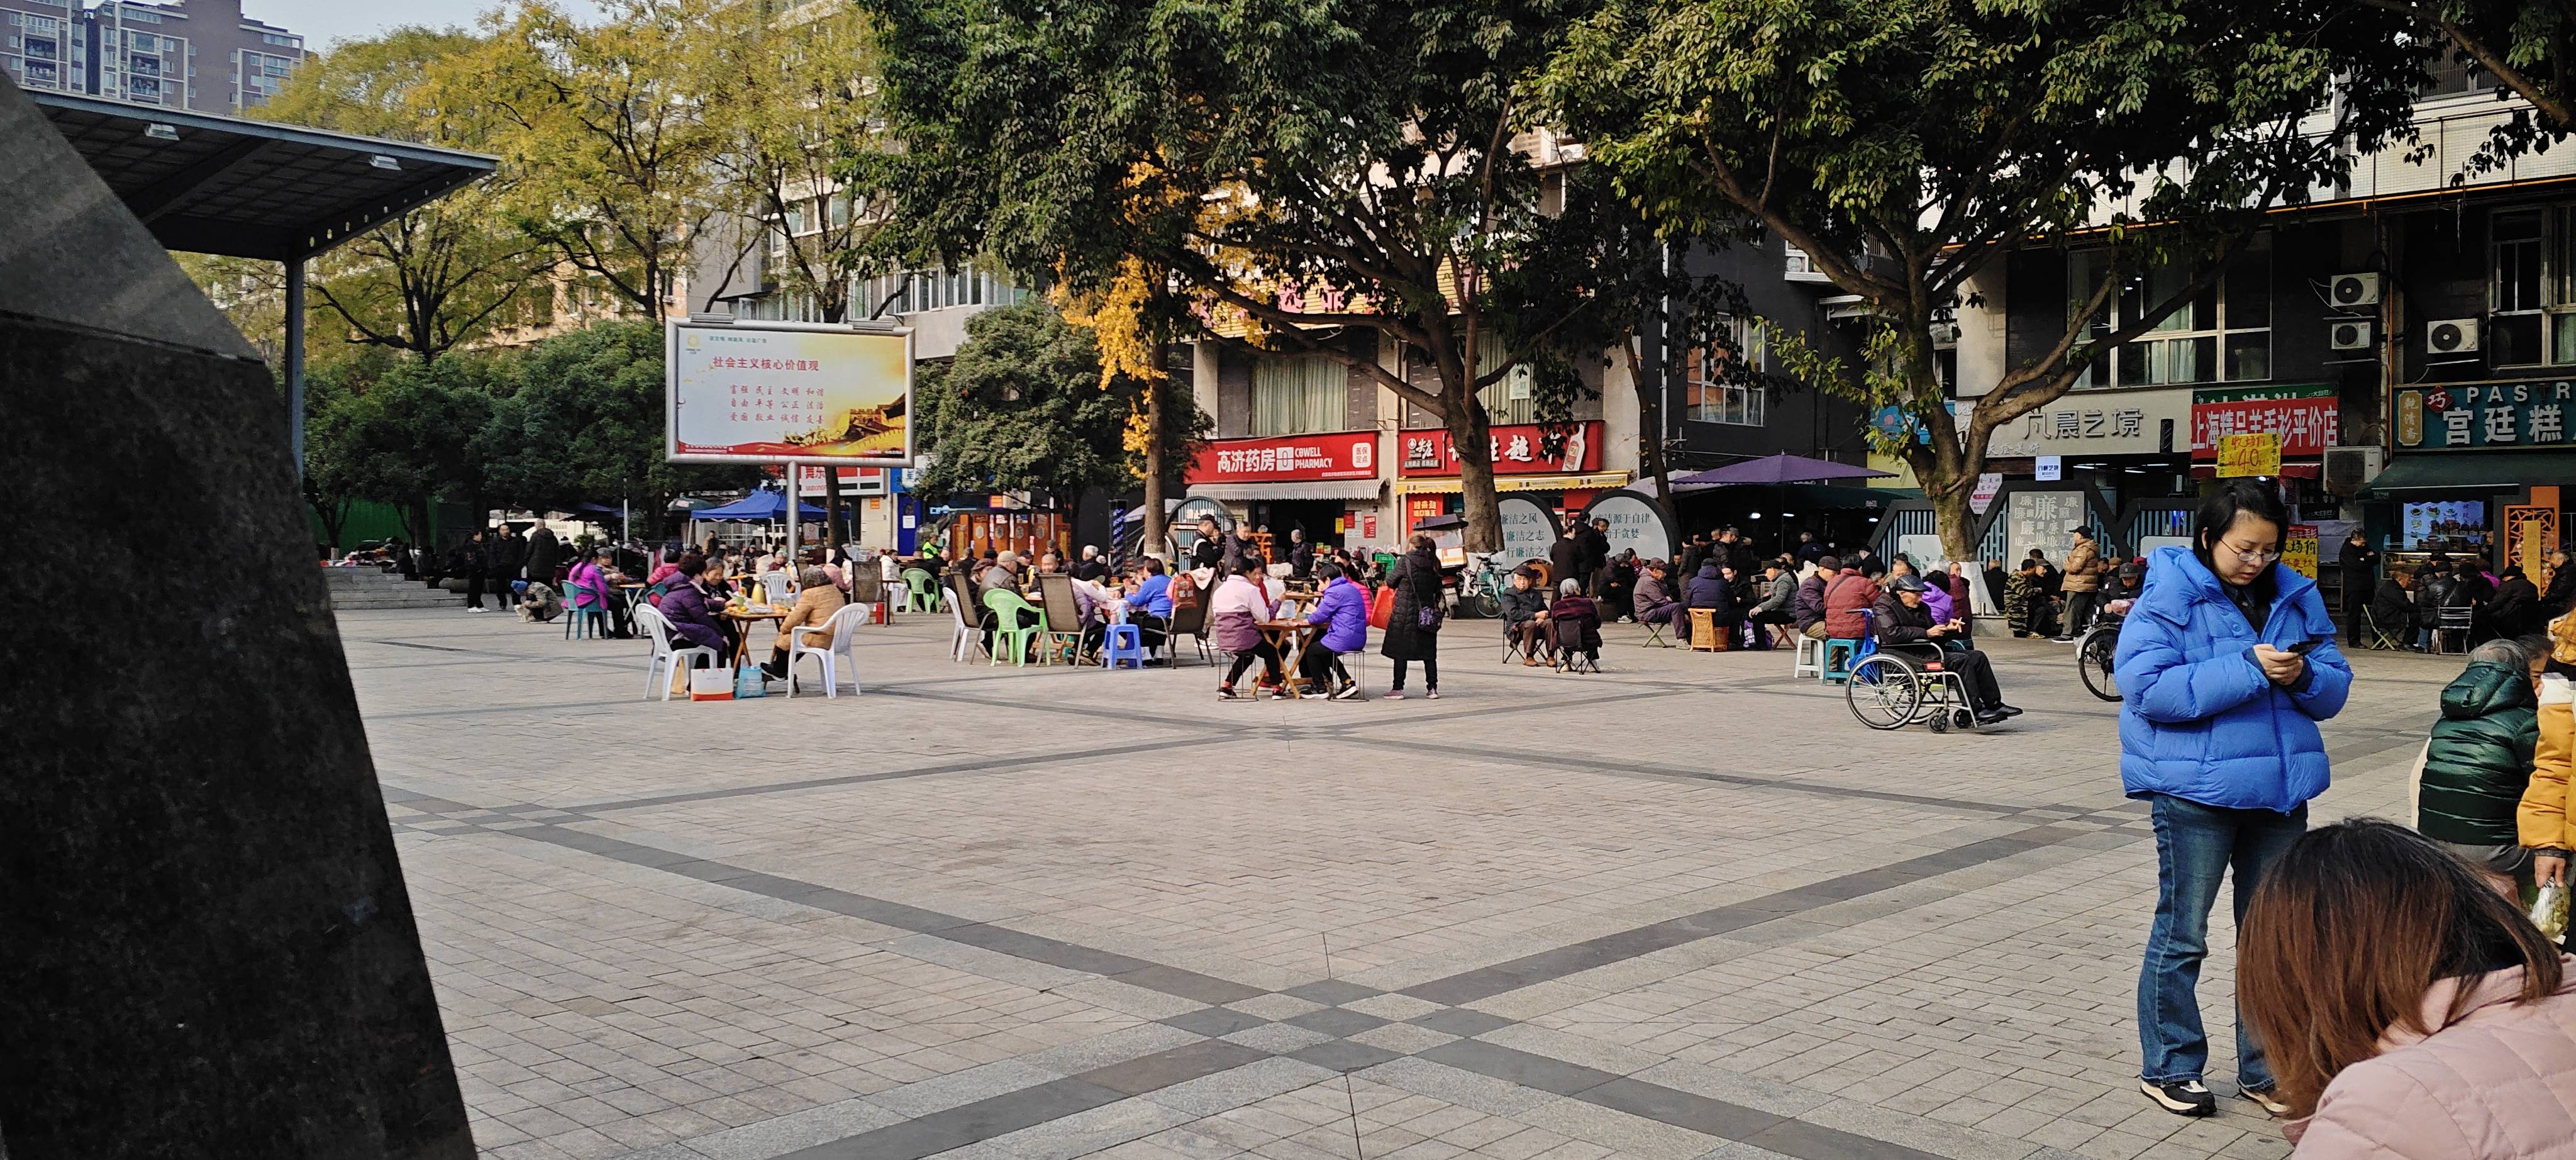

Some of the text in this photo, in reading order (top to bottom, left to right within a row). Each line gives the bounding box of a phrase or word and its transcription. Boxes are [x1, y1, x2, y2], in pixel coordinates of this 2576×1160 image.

[713, 356, 819, 371] 社会主义核心价值观
[755, 386, 773, 395] 民主
[781, 387, 799, 396] 文明
[731, 398, 748, 407] 自由
[755, 398, 774, 409] 平等
[2443, 404, 2576, 445] 宫廷糕
[1295, 447, 1322, 457] COWELL
[1217, 448, 1276, 473] 高济药房
[1295, 458, 1333, 469] PHARMACY
[2034, 494, 2058, 521] 廉
